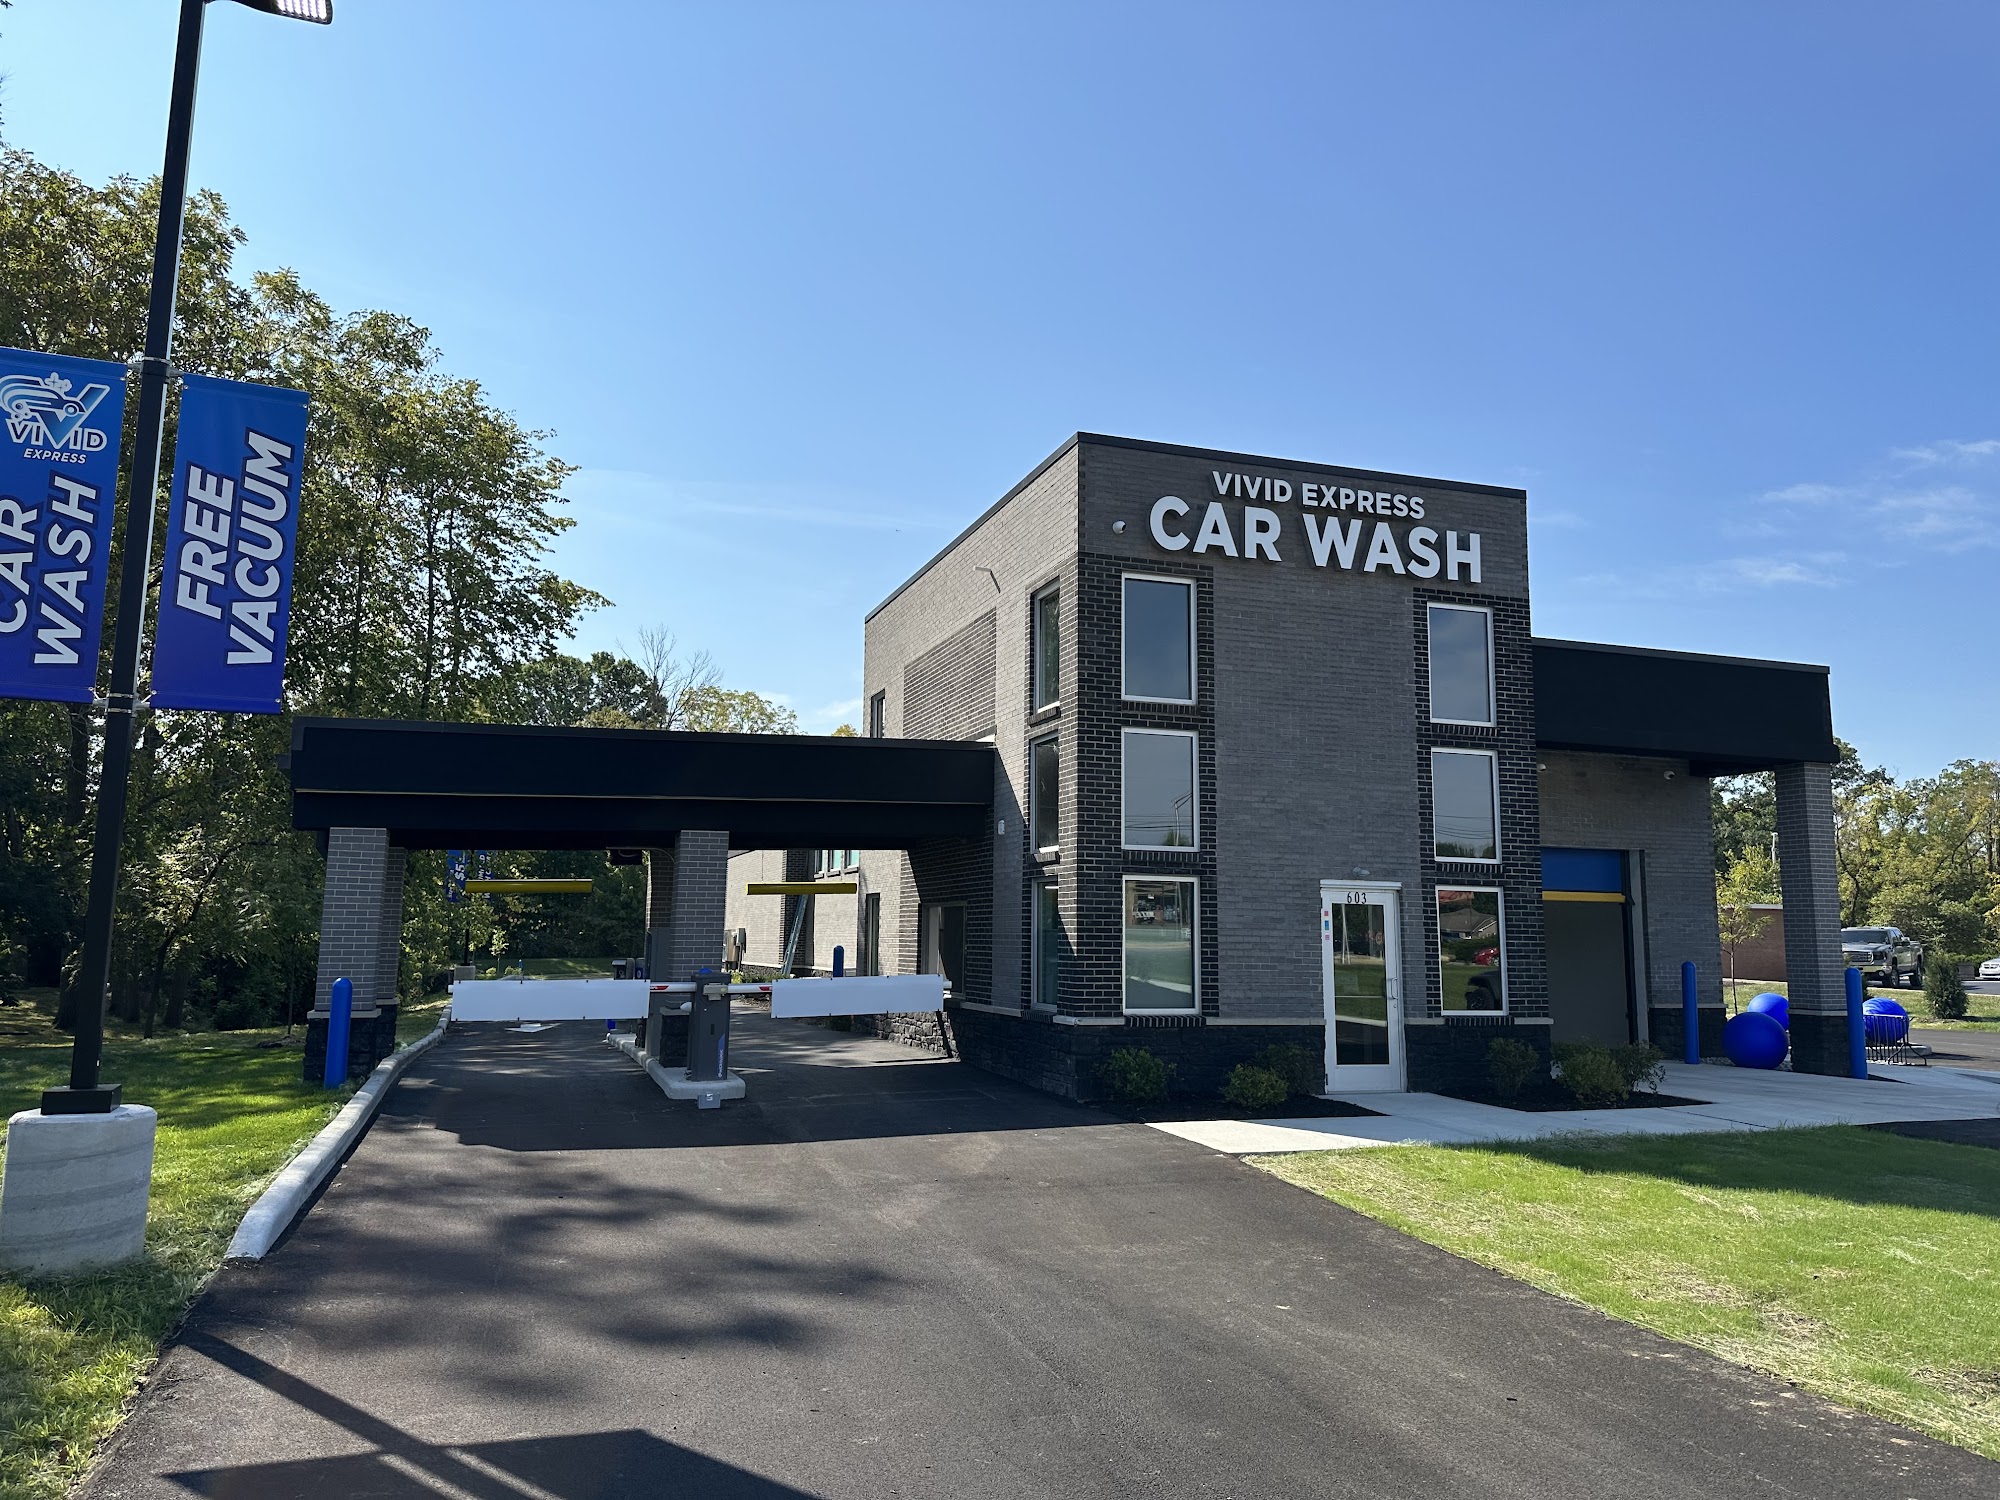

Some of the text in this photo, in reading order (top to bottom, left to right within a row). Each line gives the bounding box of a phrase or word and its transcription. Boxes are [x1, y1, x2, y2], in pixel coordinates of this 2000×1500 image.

[5, 410, 108, 452] VIVID
[23, 448, 87, 464] EXPRESS
[1149, 495, 1482, 584] CAR WASH
[1213, 471, 1425, 519] VIVID EXPRESS
[0, 499, 38, 633] CAR
[34, 475, 97, 664] WASH
[177, 464, 234, 620] FREE
[226, 430, 292, 665] VACUUM
[1347, 892, 1366, 904] 603
